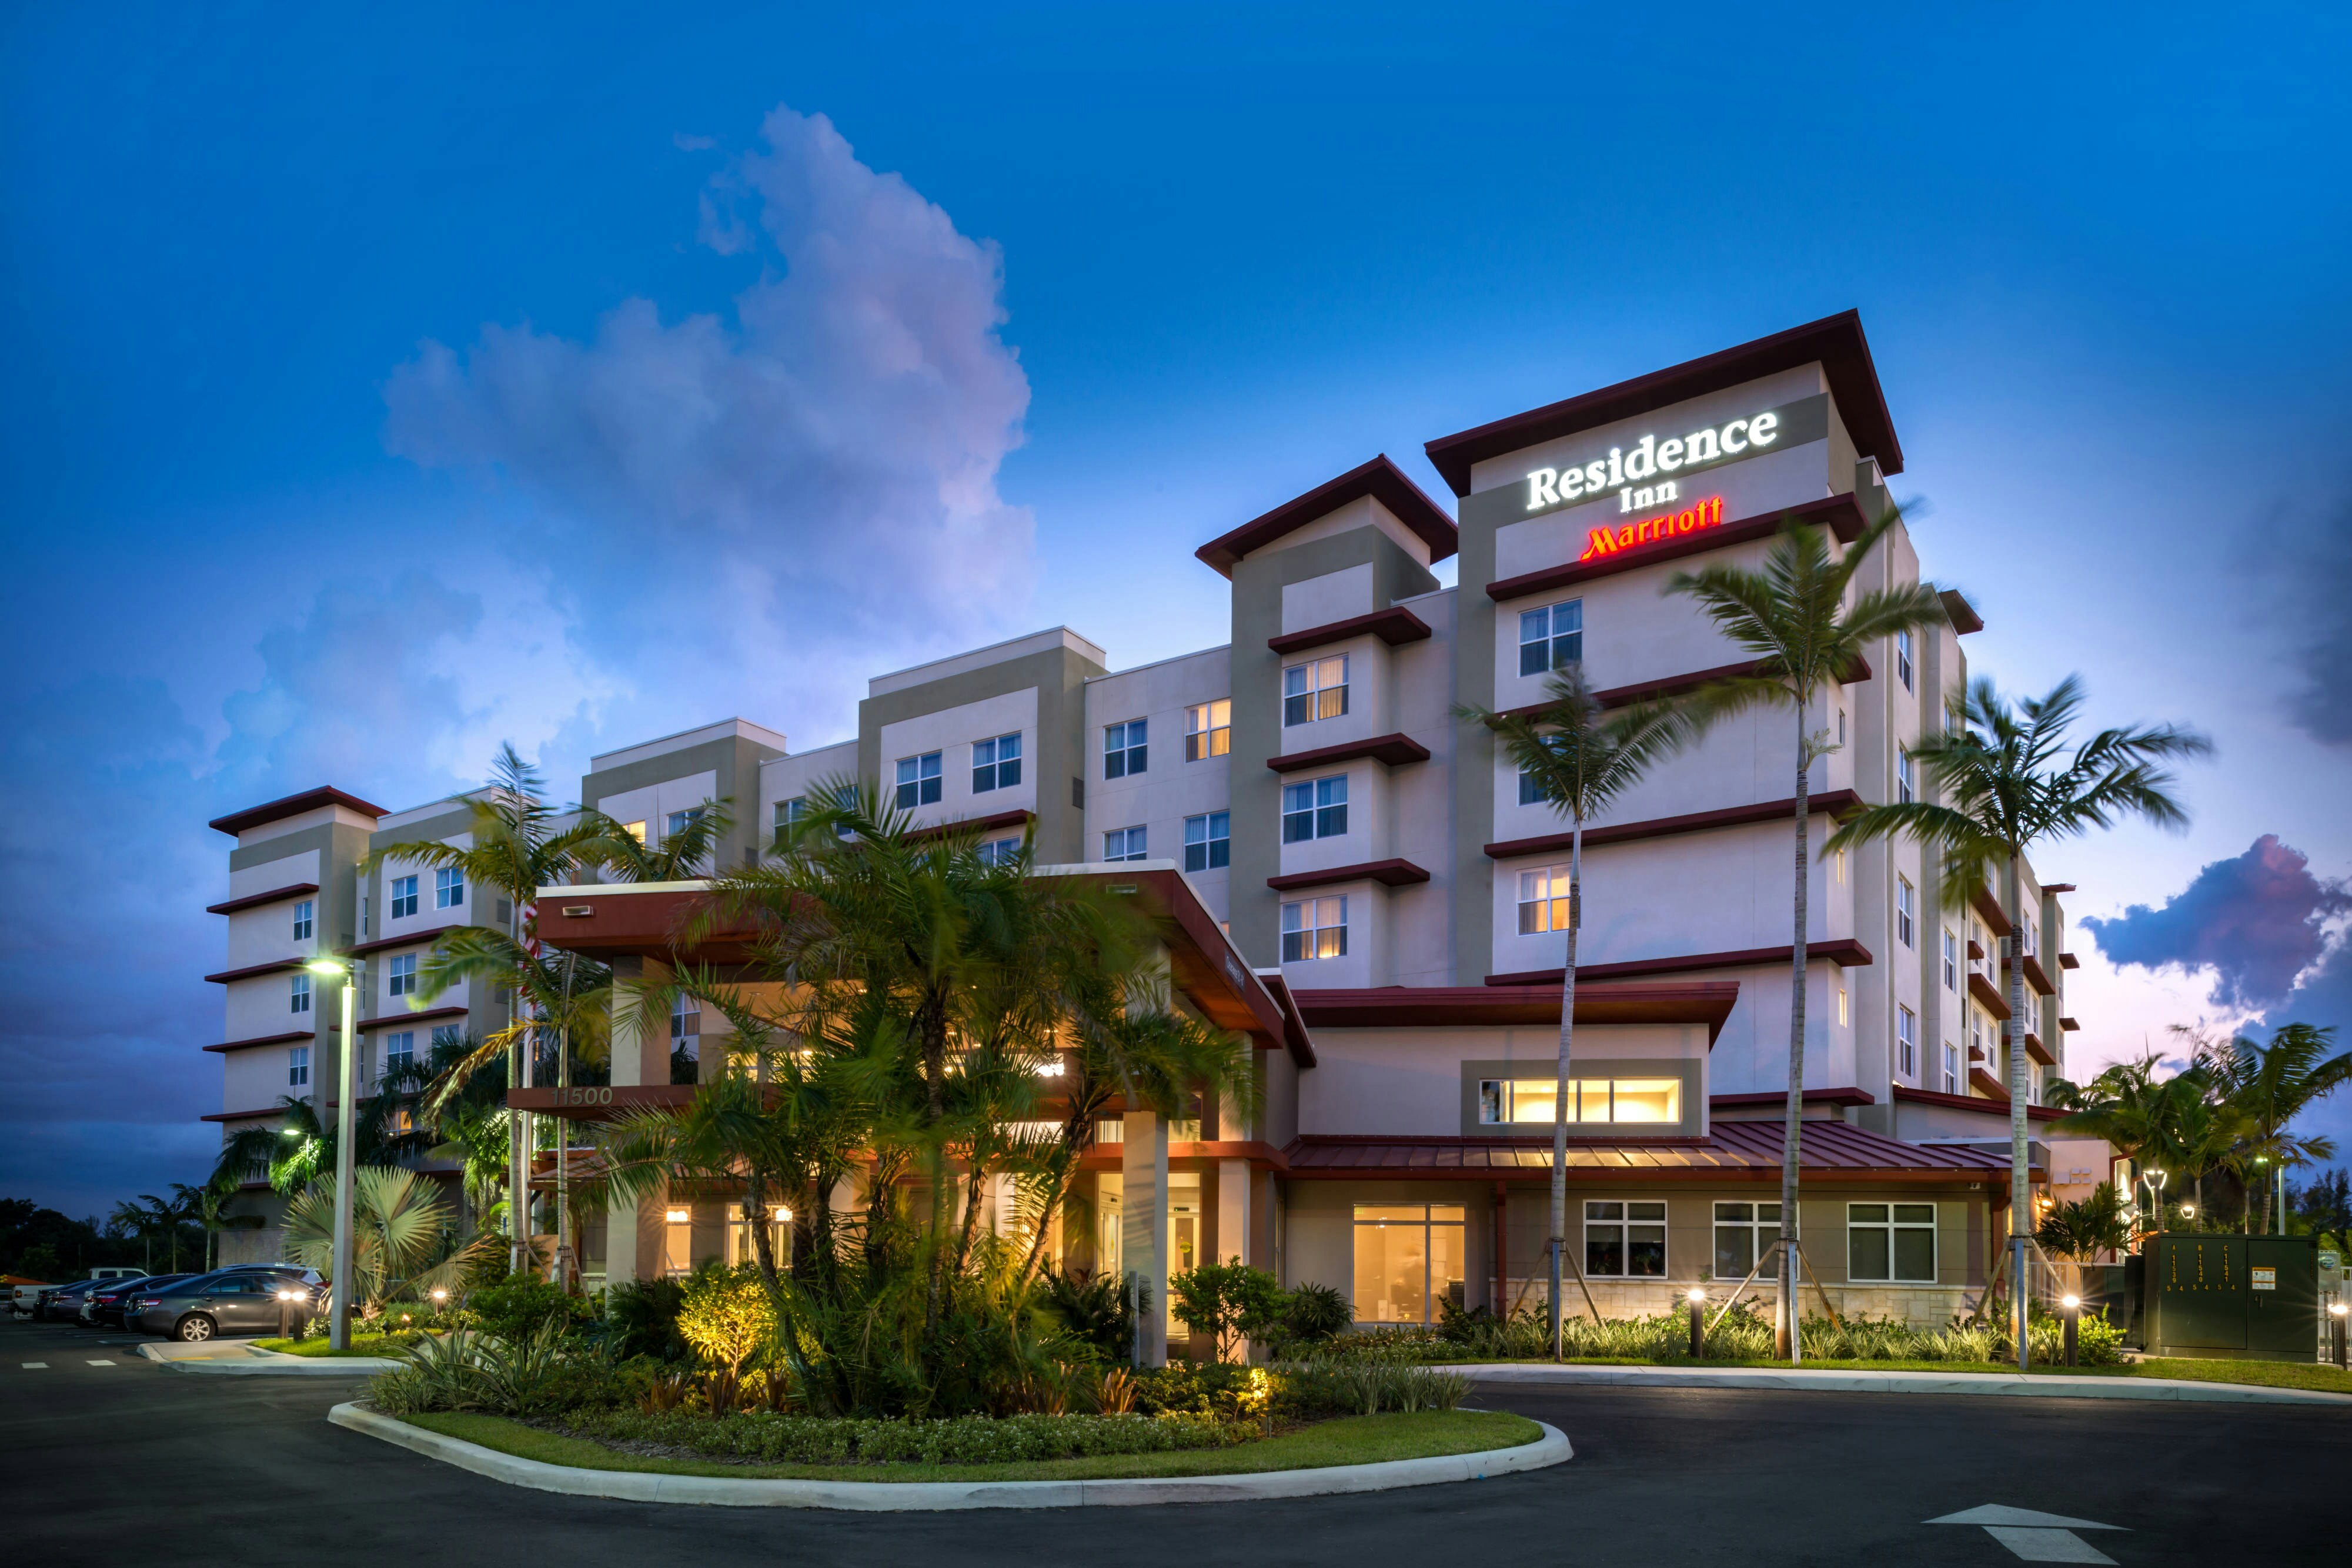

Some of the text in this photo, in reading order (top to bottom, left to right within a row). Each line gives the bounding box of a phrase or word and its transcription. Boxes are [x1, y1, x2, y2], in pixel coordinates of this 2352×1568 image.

[1526, 412, 1778, 510] Residence
[1620, 482, 1678, 513] Inn
[1580, 496, 1723, 562] Marriott
[552, 1088, 613, 1105] 11500
